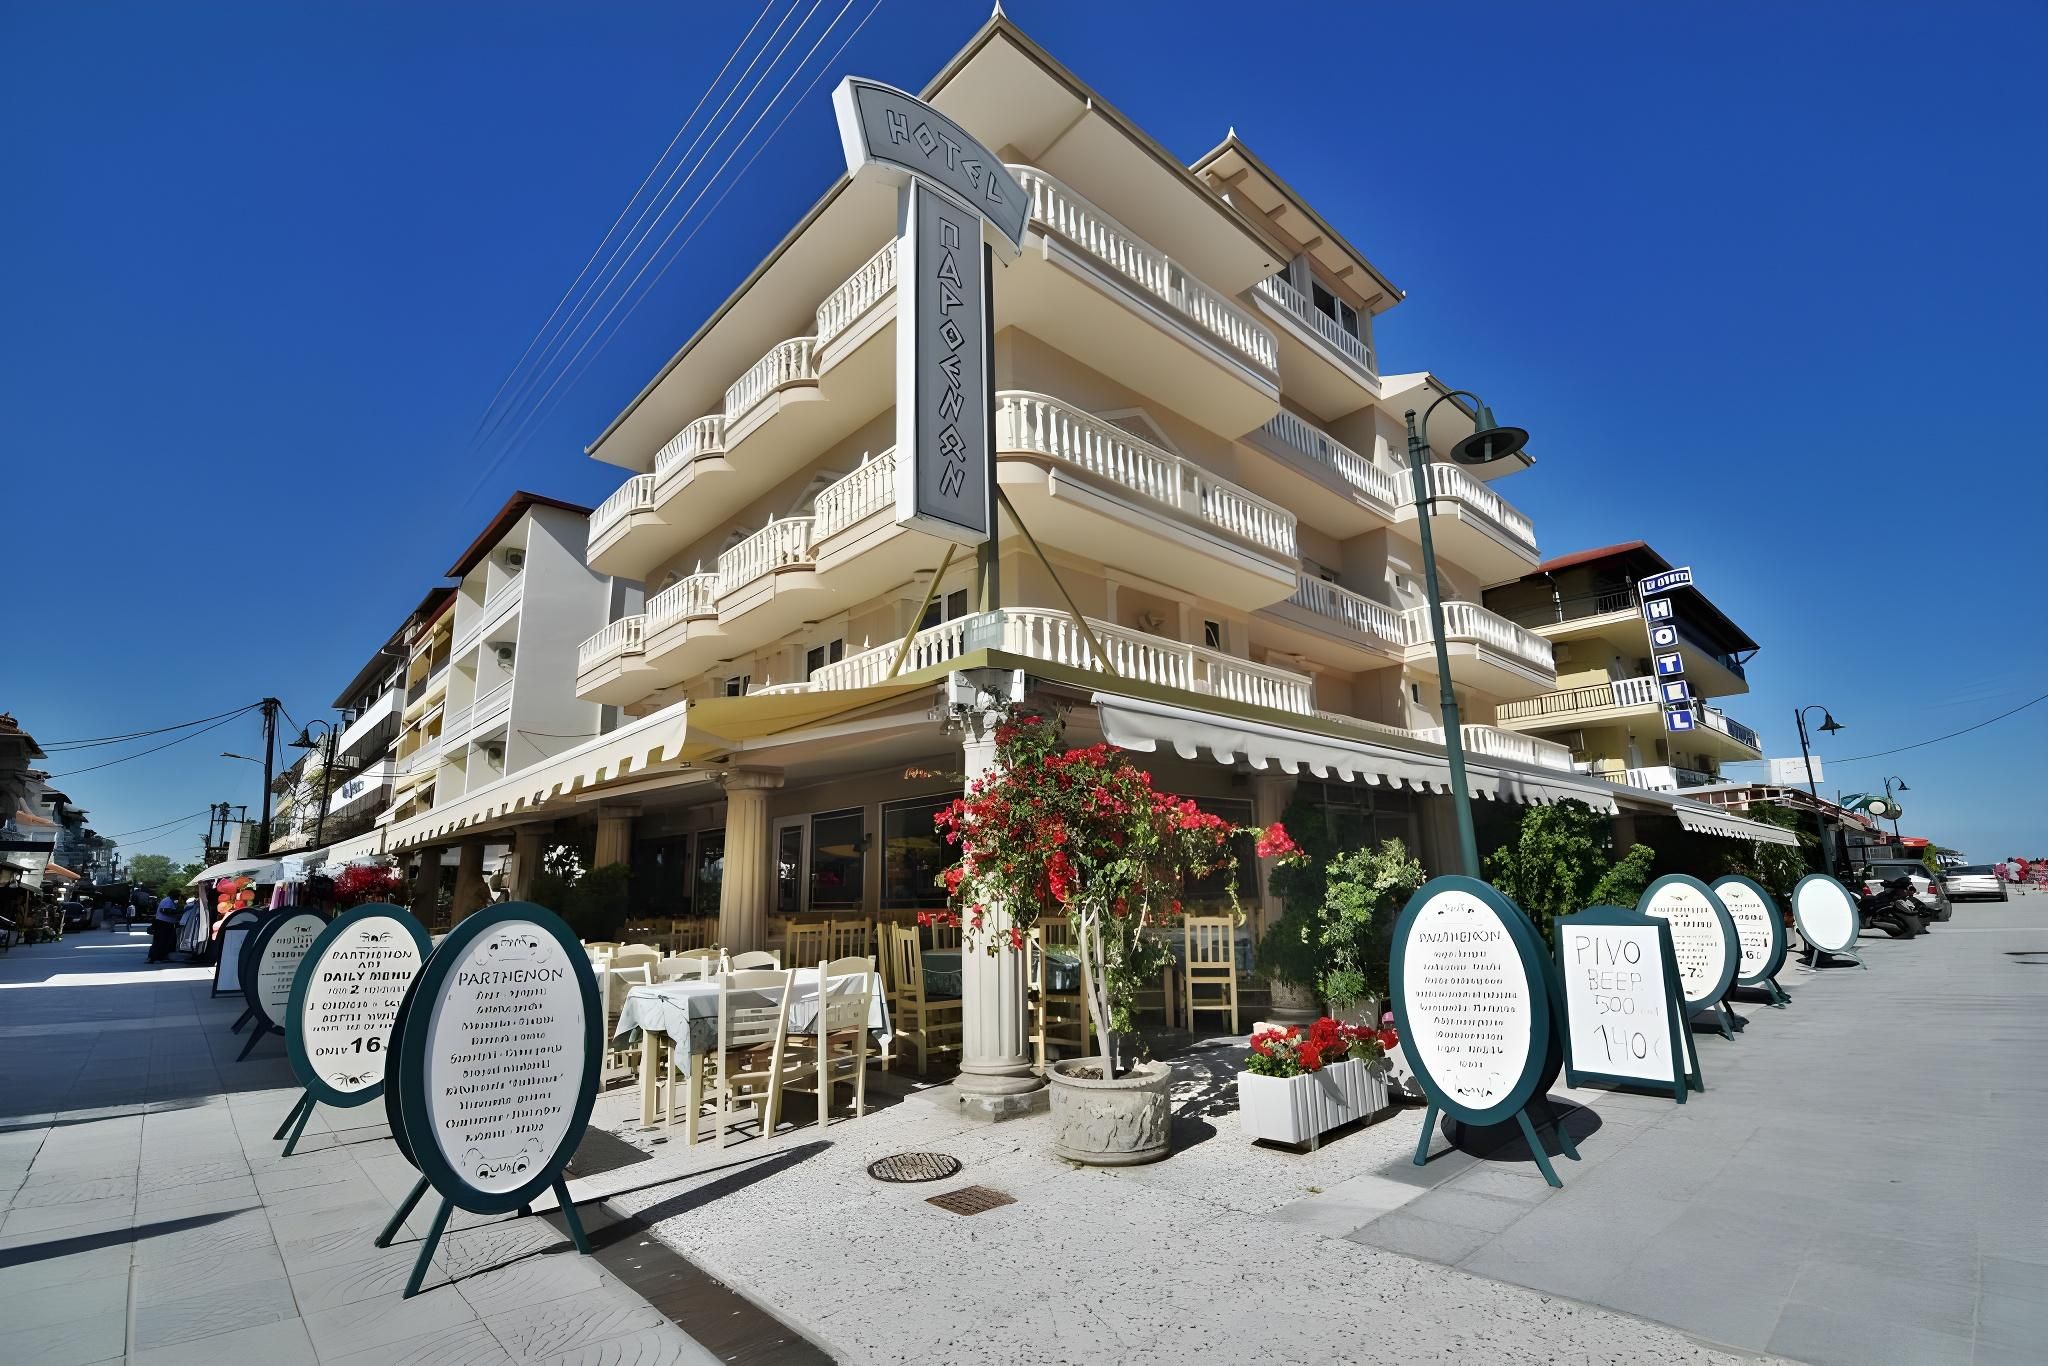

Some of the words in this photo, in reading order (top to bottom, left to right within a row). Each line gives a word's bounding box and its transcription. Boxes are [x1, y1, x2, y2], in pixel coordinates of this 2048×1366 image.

[886, 108, 1003, 204] HOTEL
[1576, 935, 1641, 965] PIVO
[323, 972, 365, 982] DAILY
[458, 967, 563, 986] PARTHENON
